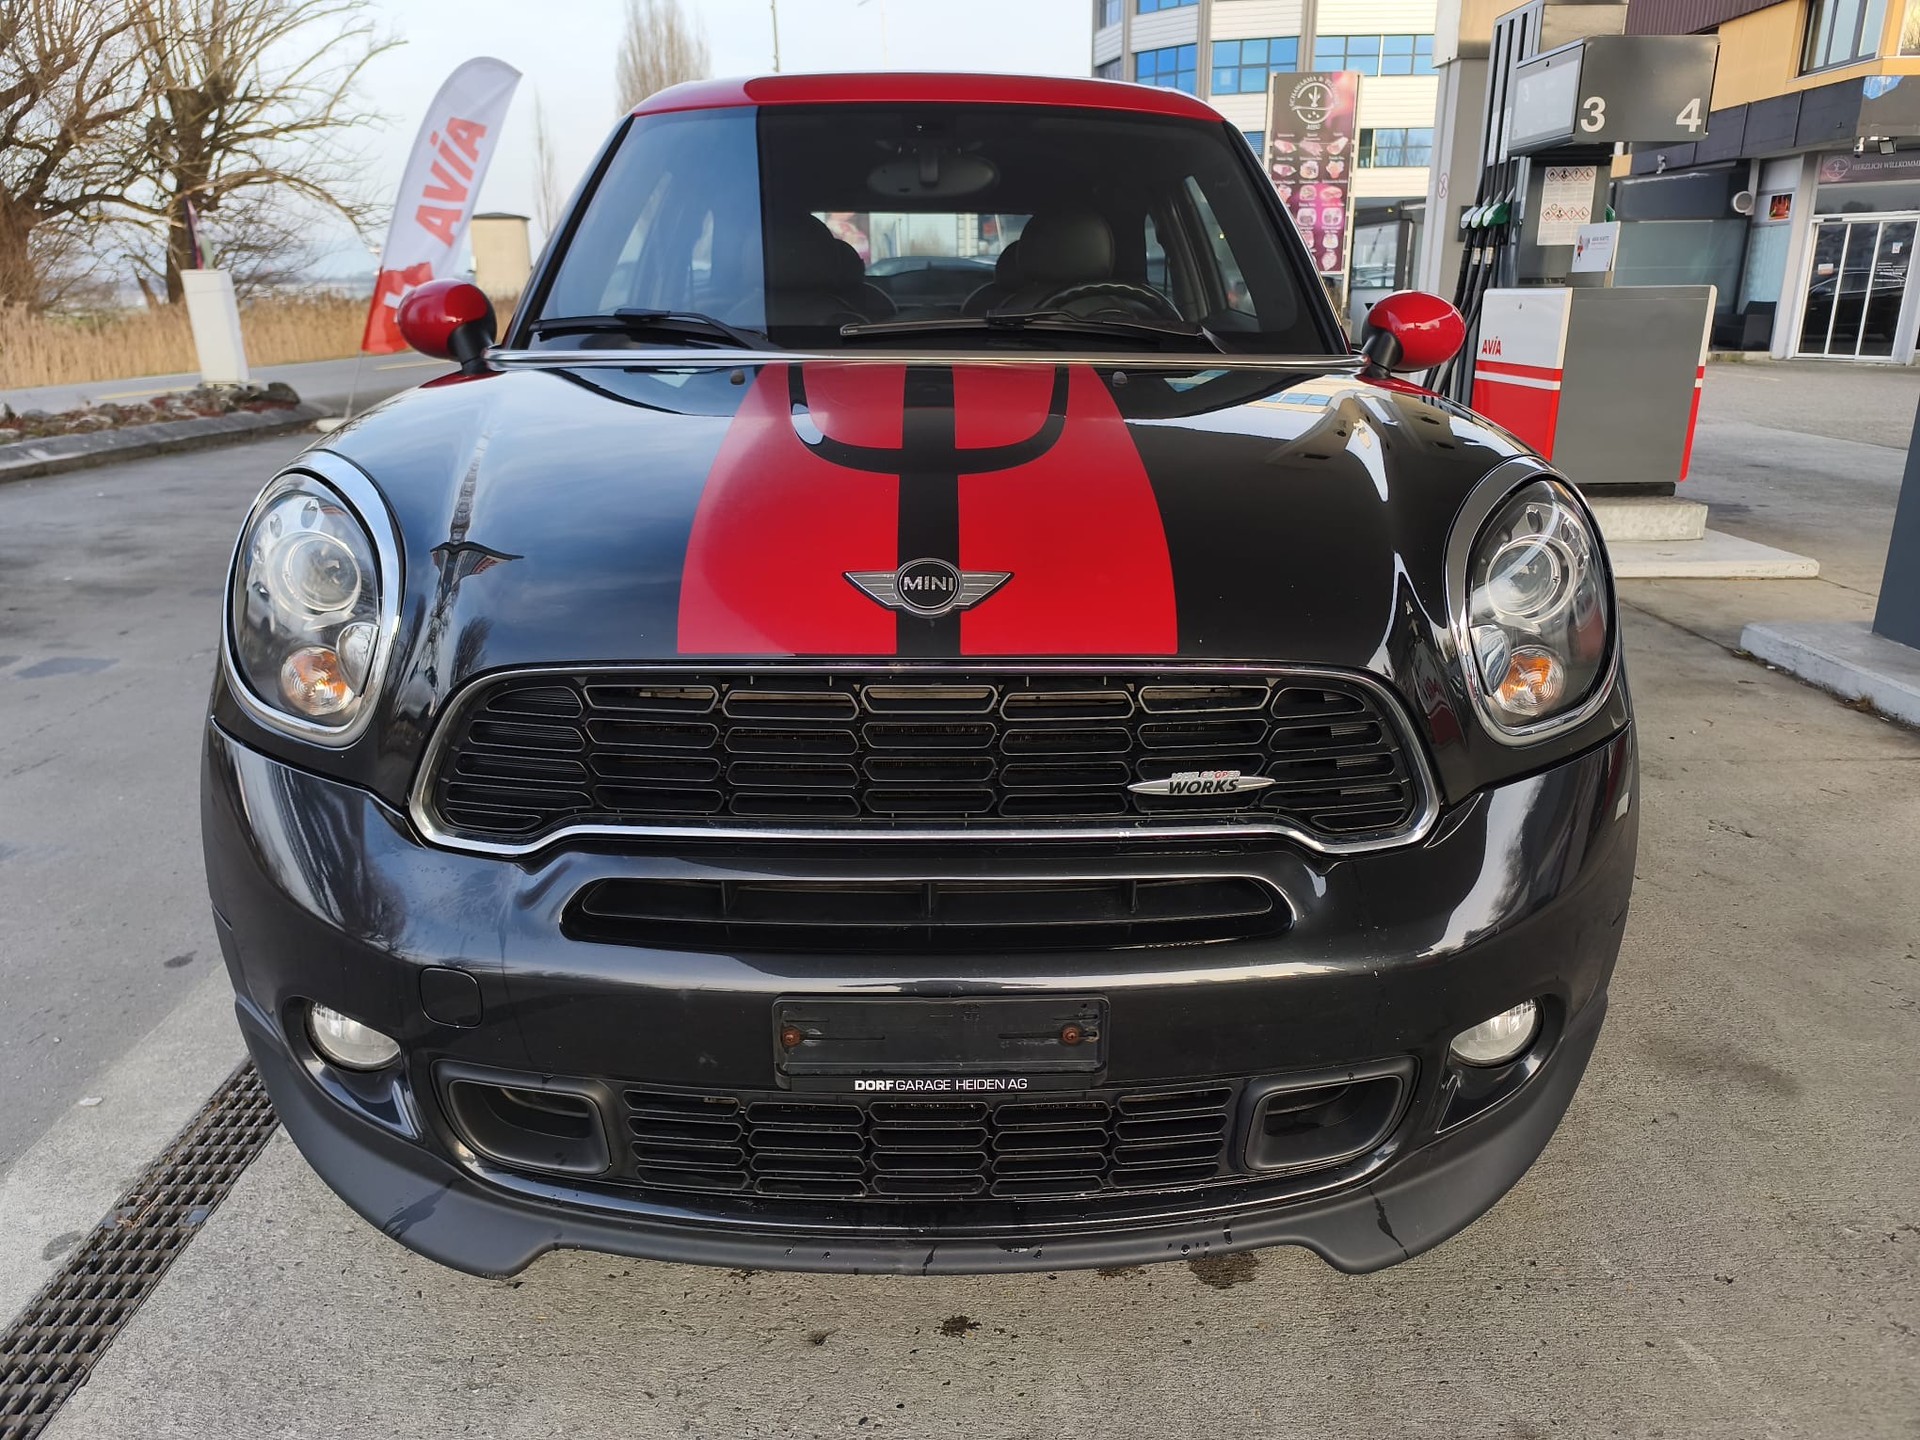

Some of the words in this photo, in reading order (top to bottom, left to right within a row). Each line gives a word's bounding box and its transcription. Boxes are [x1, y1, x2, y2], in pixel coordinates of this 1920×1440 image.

[1580, 96, 1606, 133] 3
[1675, 98, 1702, 133] 4
[903, 576, 954, 591] MINI
[1169, 779, 1239, 794] WORKS
[955, 1079, 1005, 1090] HEIDEN
[1008, 1078, 1028, 1089] AG
